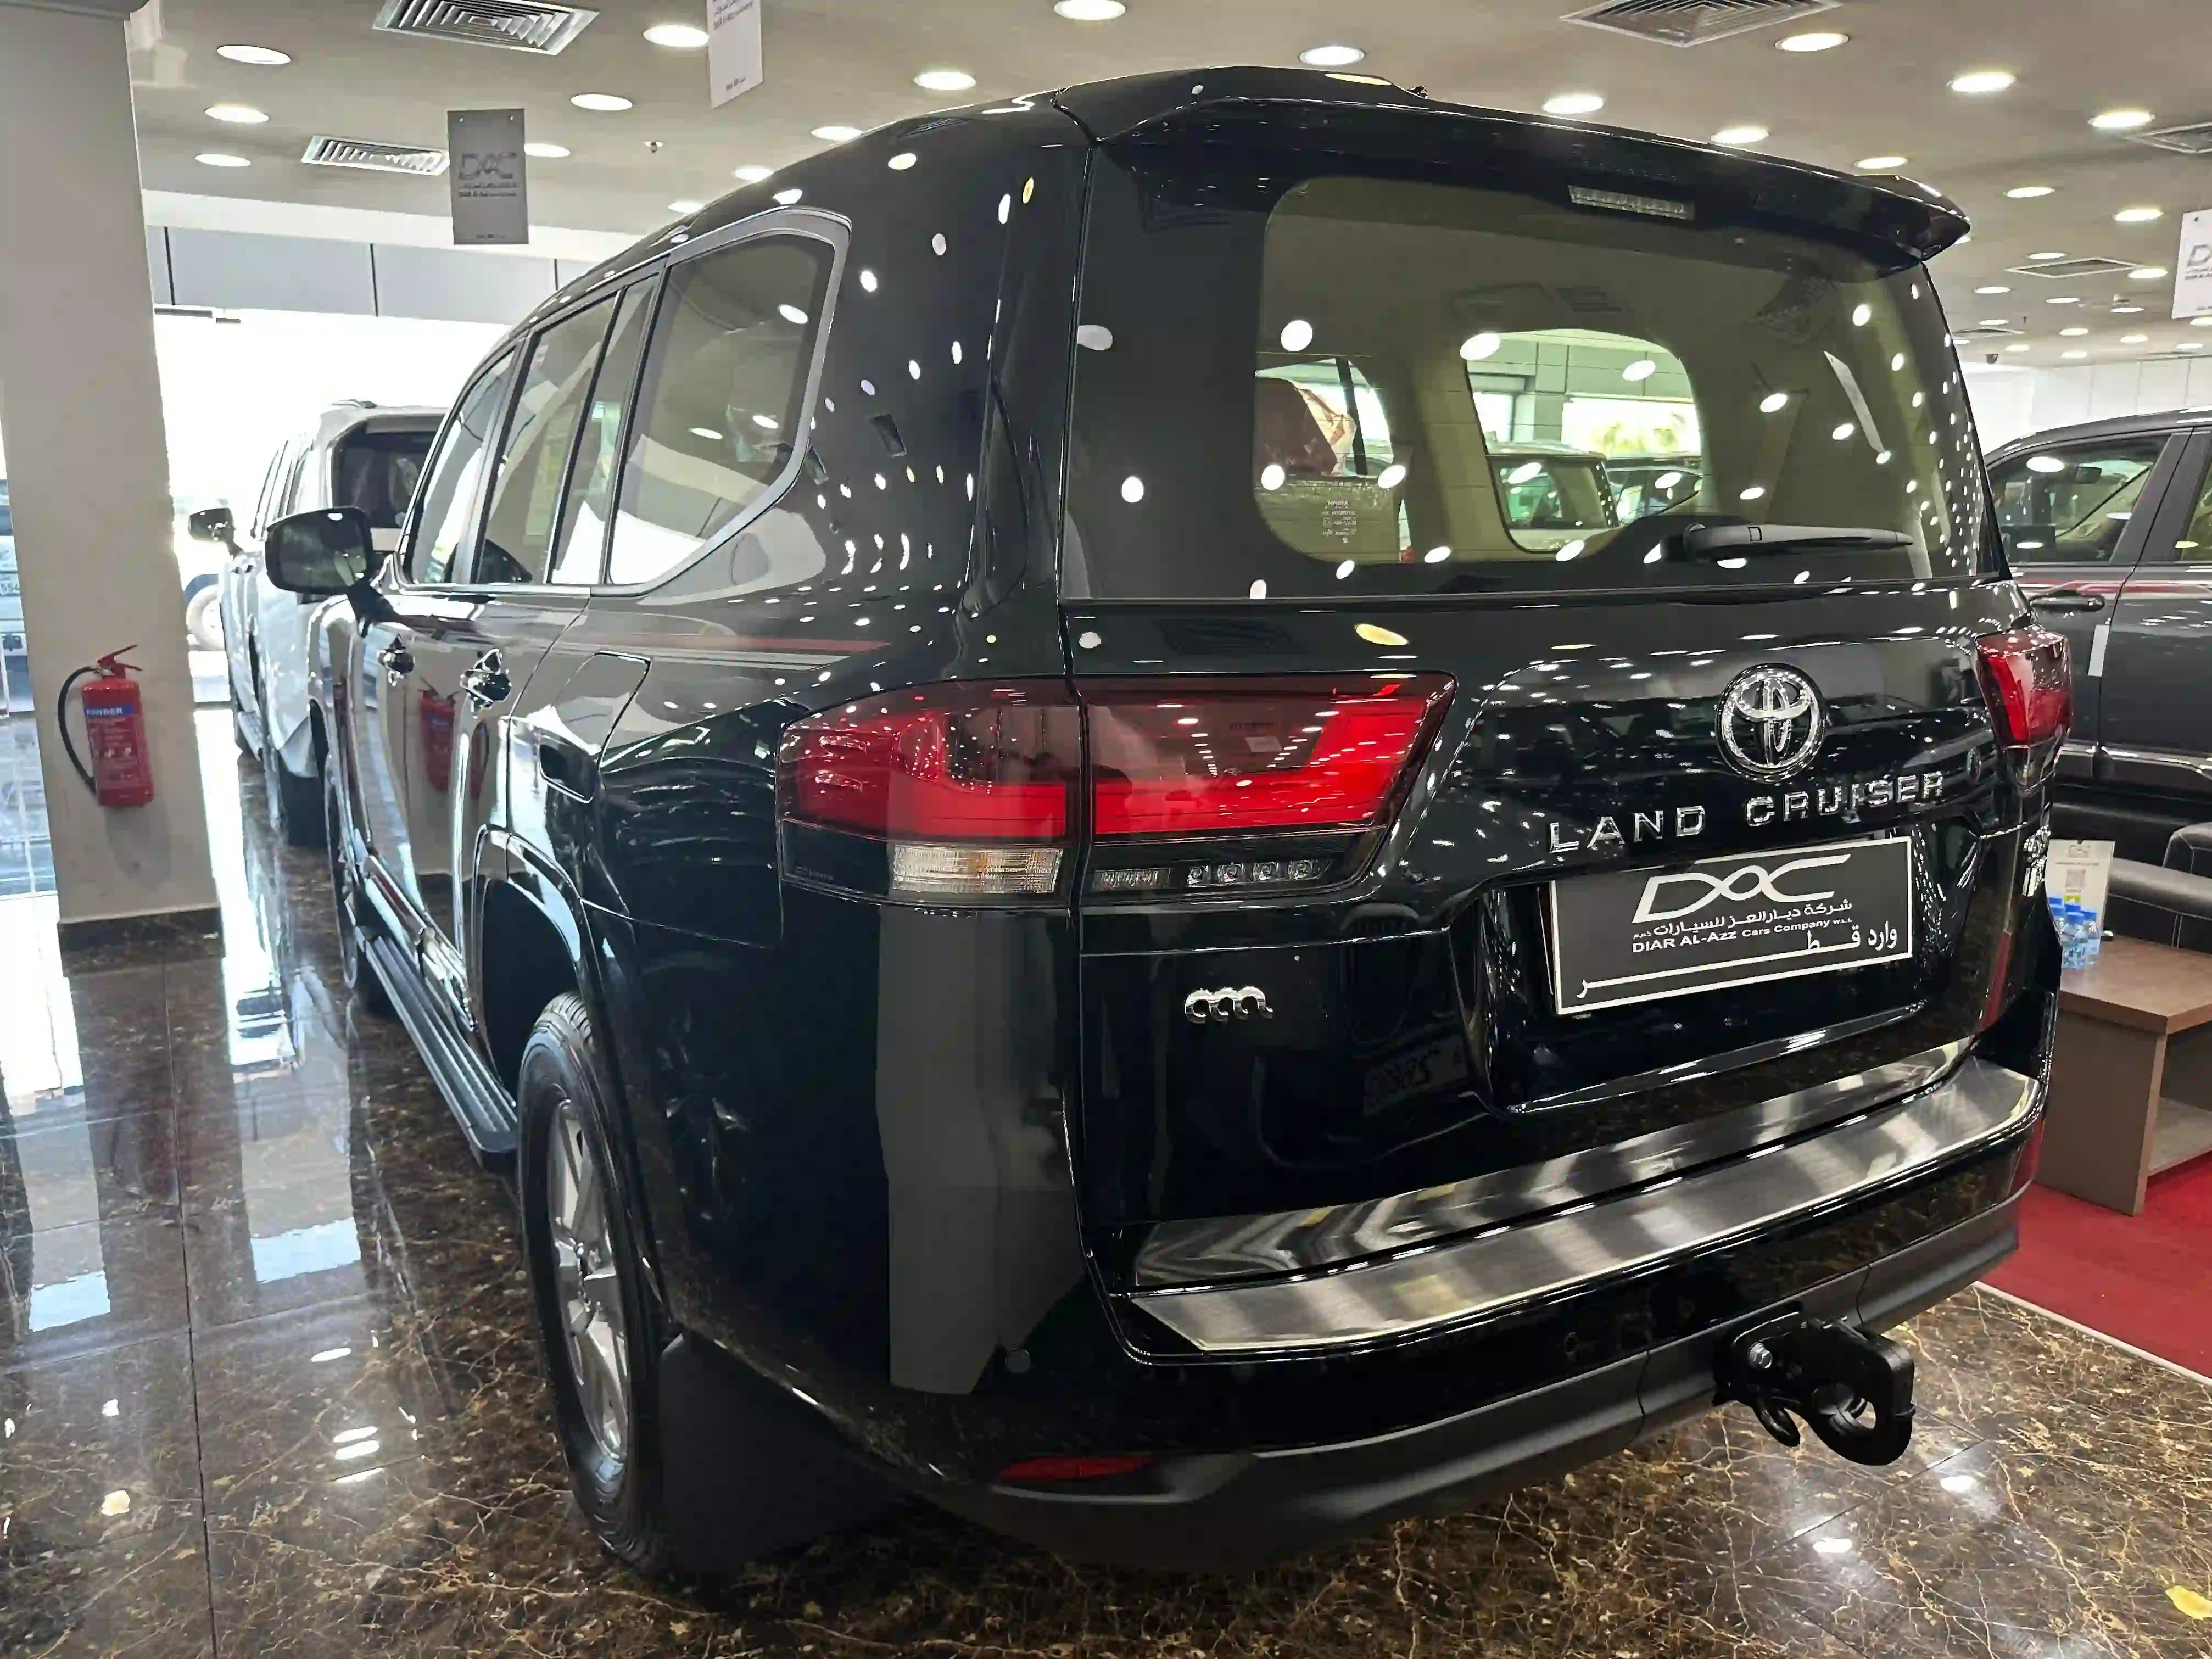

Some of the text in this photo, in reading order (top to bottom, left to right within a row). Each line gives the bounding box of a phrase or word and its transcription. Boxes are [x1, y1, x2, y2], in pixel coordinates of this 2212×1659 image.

[1549, 771, 1942, 853] LAND CRUISER
[1765, 908, 1801, 923] ديار
[1803, 898, 1852, 915] شركة
[1653, 916, 1725, 936] للسيارات
[1727, 911, 1766, 929] العز
[1632, 938, 1675, 953] DIAR
[1742, 927, 1770, 937] Cars
[1774, 919, 1830, 932] Company
[1868, 920, 1897, 951] وارد
